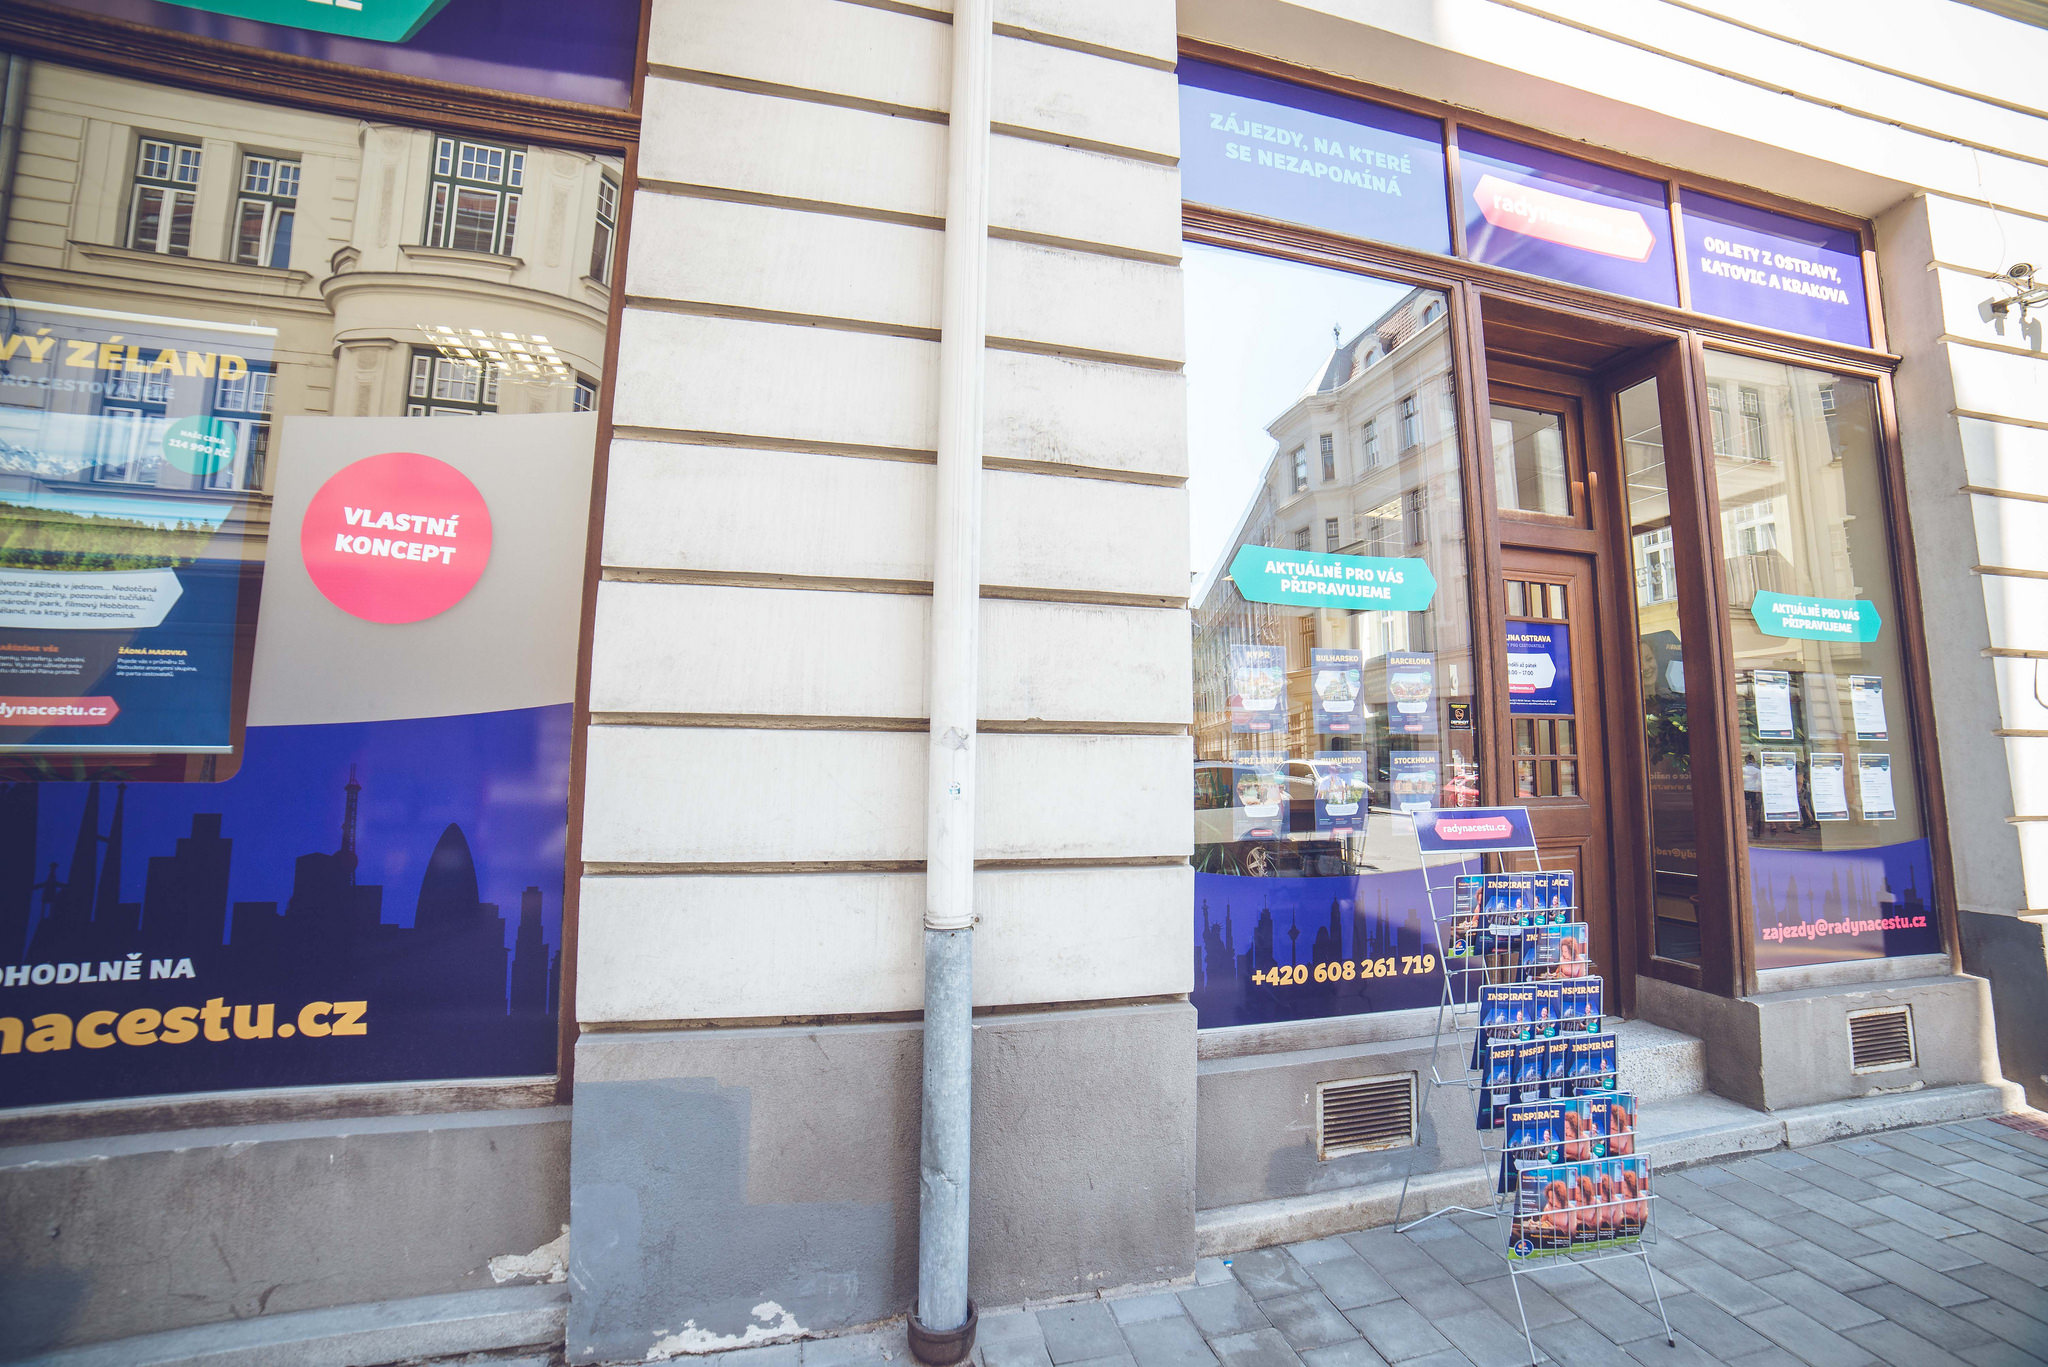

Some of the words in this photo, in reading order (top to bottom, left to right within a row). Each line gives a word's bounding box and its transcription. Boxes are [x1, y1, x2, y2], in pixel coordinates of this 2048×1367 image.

[1208, 111, 1308, 152] ZÁJEZDY,
[1313, 136, 1345, 158] NA
[1348, 144, 1412, 175] KTERÉ
[1224, 142, 1252, 162] SE
[1257, 148, 1402, 197] NEZAPOMÍNÁ
[1703, 236, 1760, 263] ODLETY
[1761, 250, 1773, 266] Z
[1773, 253, 1842, 285] OSTRAVY,
[1700, 256, 1767, 286] KATOVIC
[1768, 273, 1781, 290] A
[1781, 276, 1850, 305] KRAKOVA
[65, 335, 248, 381] ZÉLAND
[0, 373, 34, 388] RO
[38, 377, 175, 400] CESTOVATELE
[343, 506, 461, 538] VLASTNÍ
[335, 533, 457, 565] KONCEPT
[1264, 560, 1343, 579] AKTUÁLNĚ
[1345, 567, 1374, 582] PRO
[1376, 567, 1404, 584] VÁS
[1280, 575, 1392, 600] PŘIPRAVUJEME
[1771, 602, 1821, 617] AKTUÁLNĚ
[1821, 607, 1841, 619] PRO
[1841, 608, 1861, 621] VÁS
[1782, 615, 1853, 633] PŘIPRAVUJEME
[1521, 634, 1551, 642] OSTRAVA
[1315, 654, 1359, 663] BULHARSKO
[1389, 657, 1431, 665] BARCELONA
[1255, 756, 1284, 765] LANKA
[1393, 756, 1436, 765] STOCKHOLM
[1442, 823, 1507, 835] radynacestu.cz
[1487, 879, 1532, 889] INSPIRACE
[1761, 914, 1927, 944] zajezdy@radynacestu.cz
[0, 952, 143, 988] HODLNĚ
[149, 957, 196, 981] NA
[1251, 964, 1309, 986] +420
[1313, 960, 1356, 983] 608
[1360, 956, 1398, 979] 261
[1401, 953, 1436, 975] 719
[1487, 992, 1533, 1001] INSPIRACE
[1571, 1040, 1615, 1052] INSPIRACE
[1512, 1109, 1560, 1122] INSPIRACE
